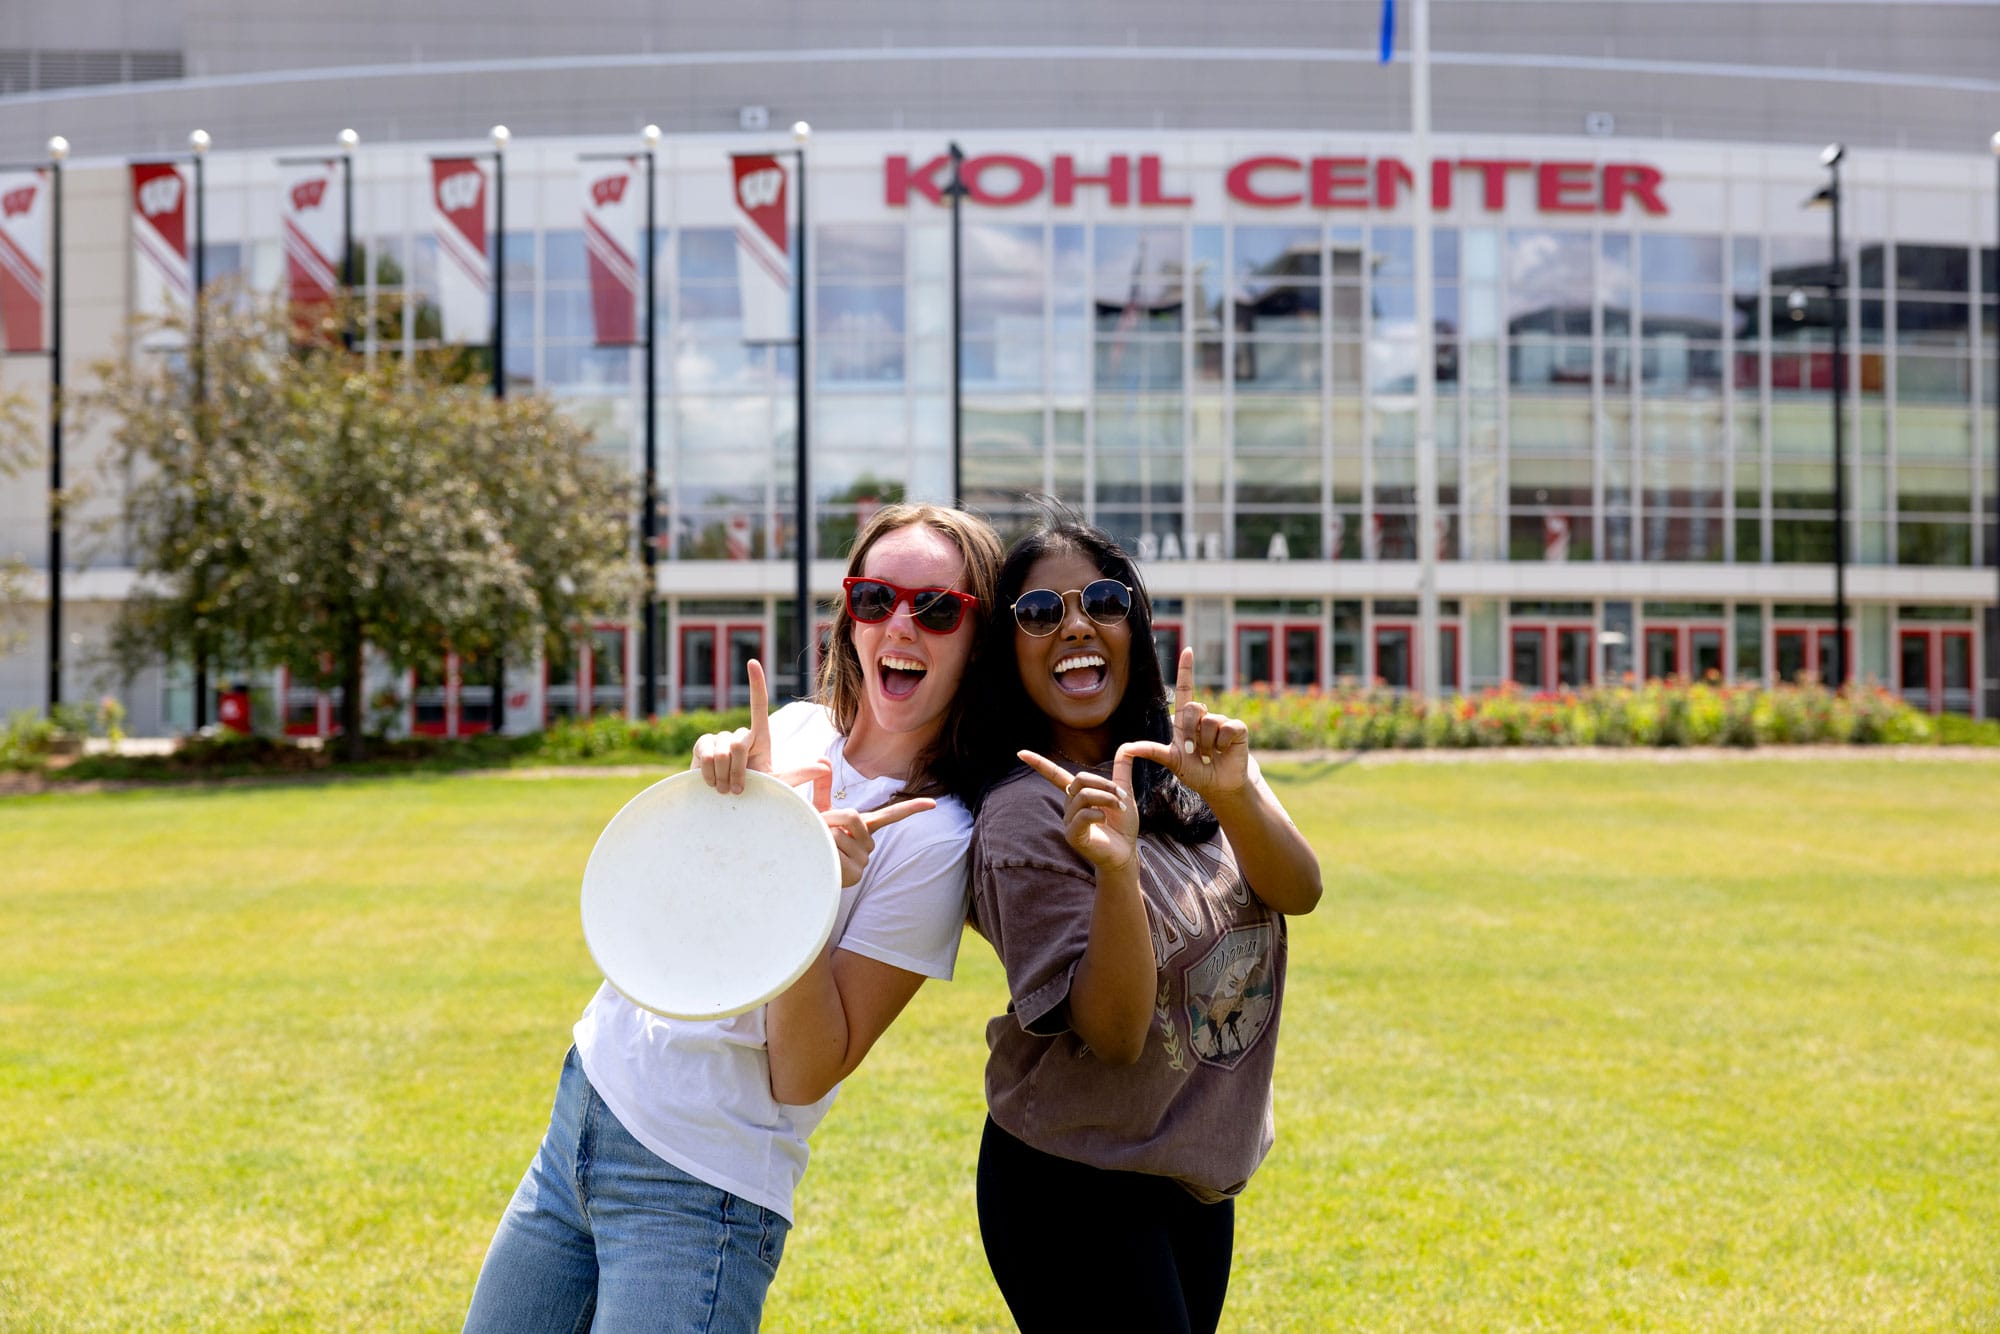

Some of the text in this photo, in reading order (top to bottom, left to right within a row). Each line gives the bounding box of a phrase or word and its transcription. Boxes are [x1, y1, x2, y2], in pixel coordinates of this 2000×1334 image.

[438, 171, 482, 212] W
[590, 174, 629, 207] W
[738, 168, 783, 210] W
[885, 154, 1669, 215] KOHL CENTER
[1267, 532, 1290, 560] A
